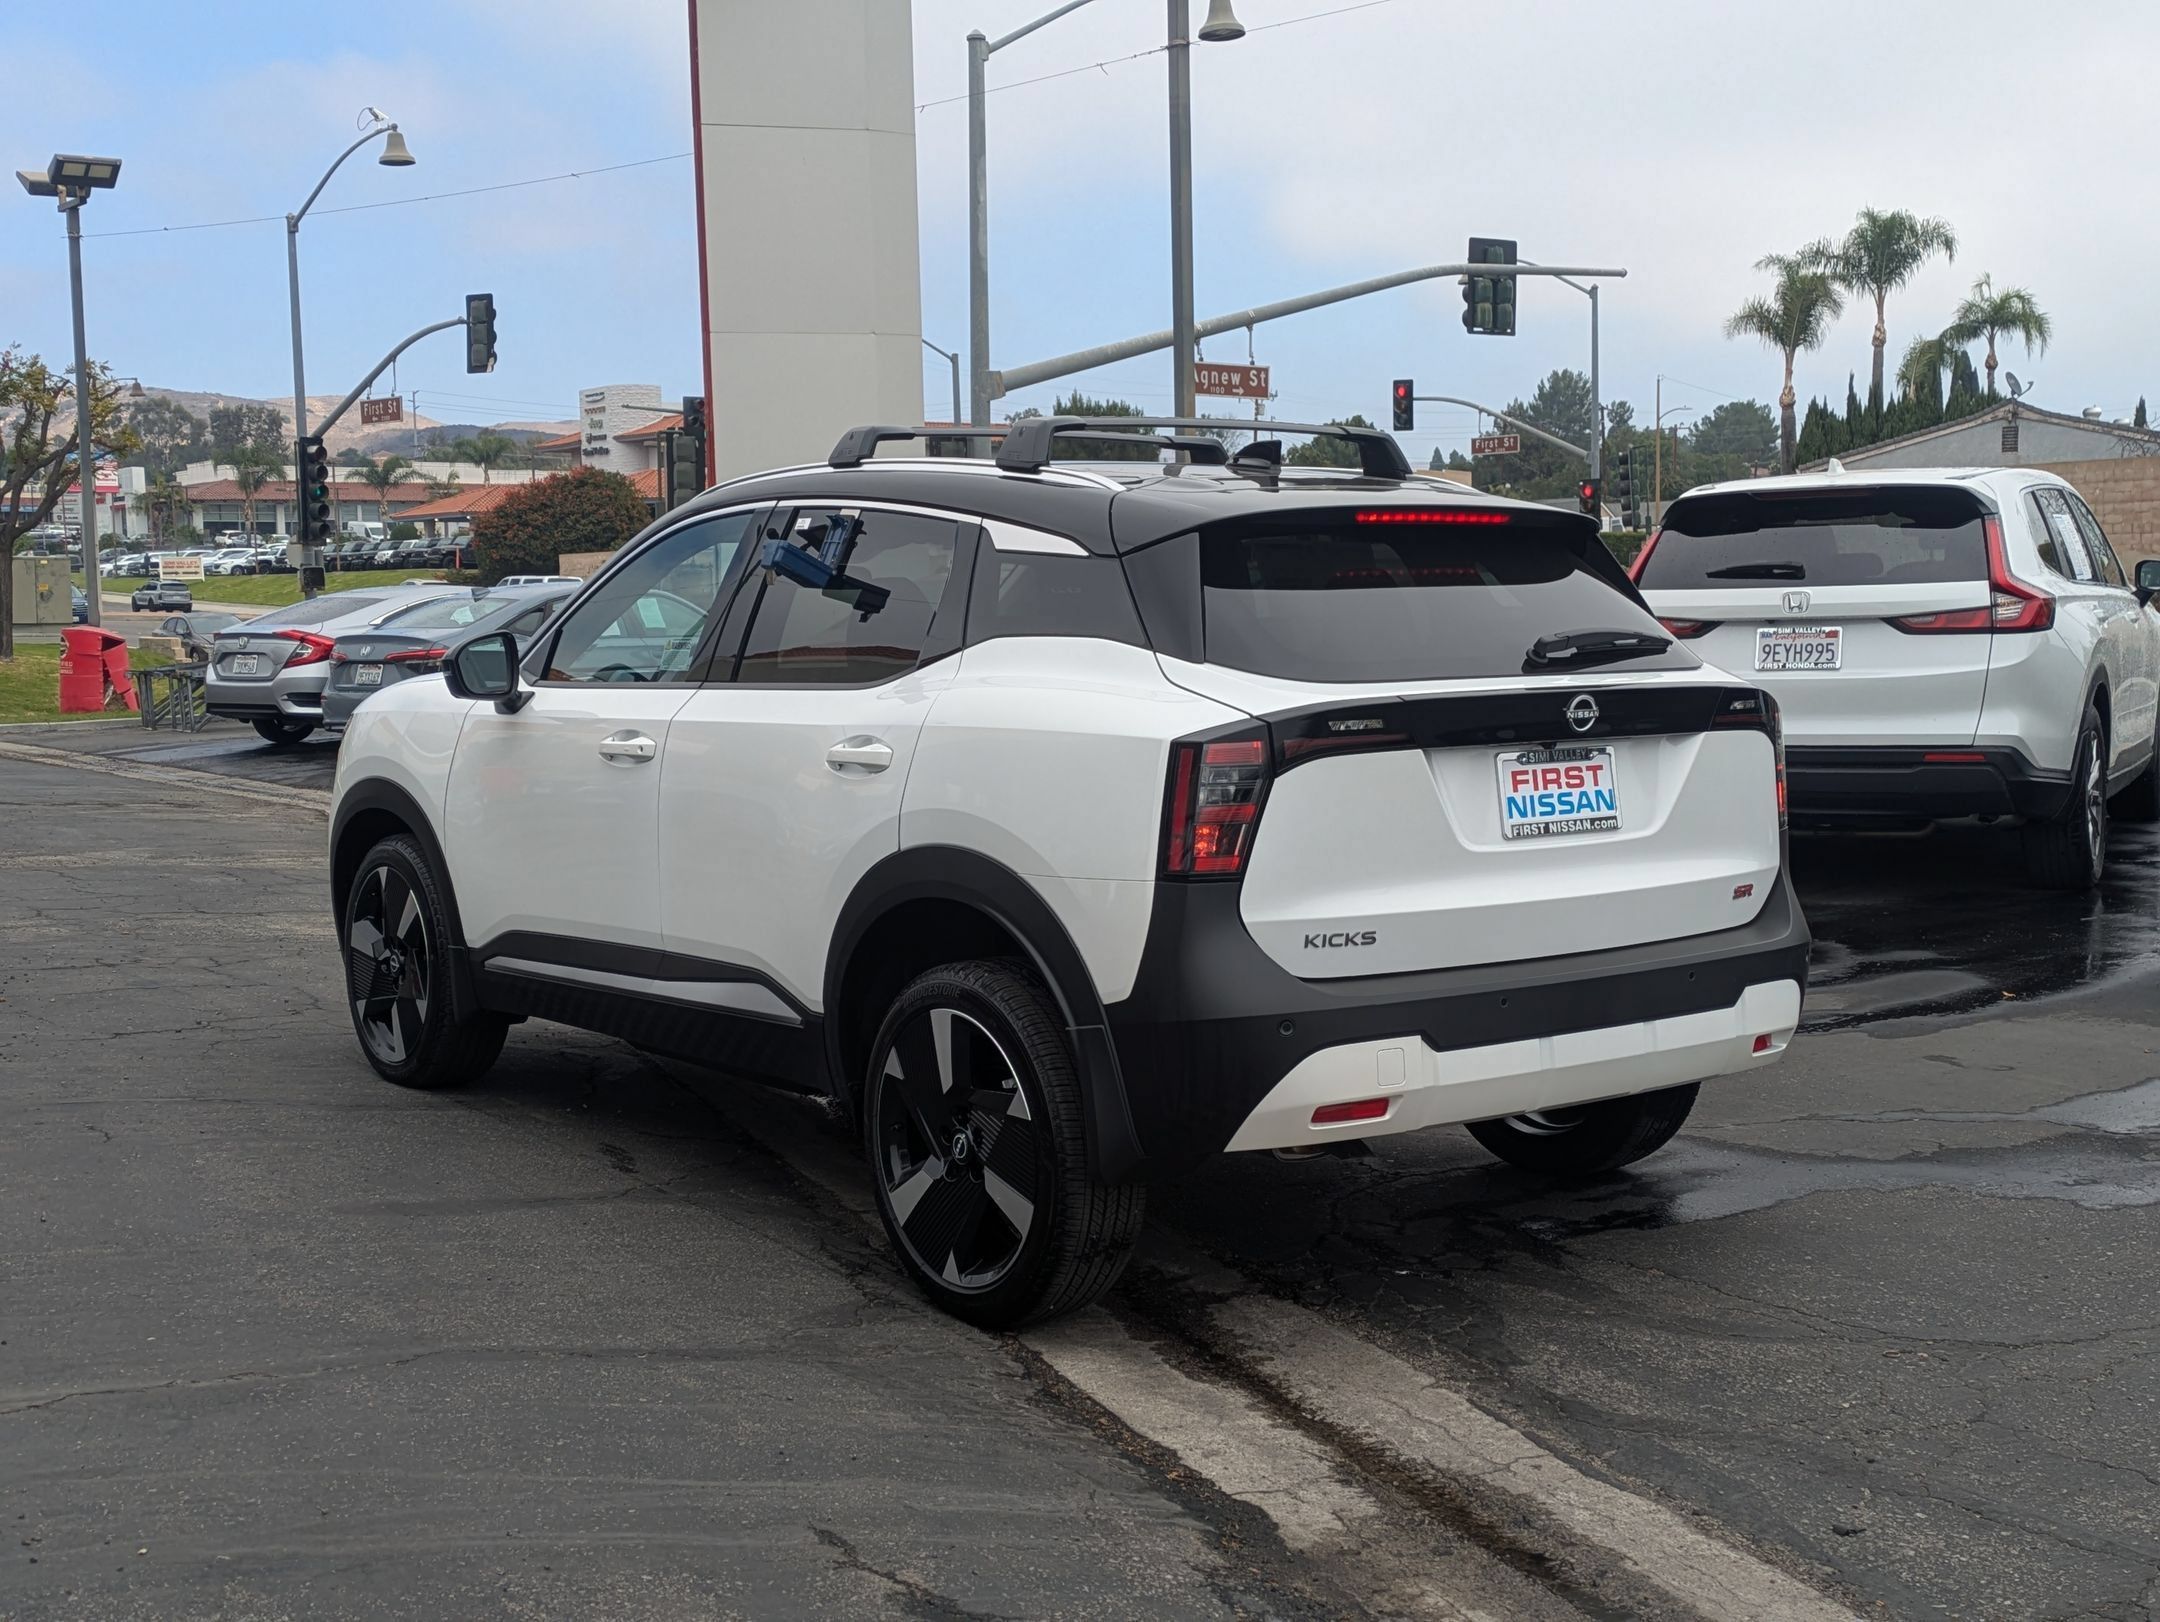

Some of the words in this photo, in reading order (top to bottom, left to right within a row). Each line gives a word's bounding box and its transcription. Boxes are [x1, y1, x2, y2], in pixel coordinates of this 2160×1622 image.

[1249, 369, 1267, 388] St
[363, 401, 384, 417] First
[388, 400, 397, 413] St
[1475, 438, 1498, 449] First
[1503, 437, 1514, 447] St
[1794, 626, 1820, 634] VALLEY
[1761, 642, 1835, 663] 9EYH995
[1567, 711, 1599, 719] NISSAN
[1529, 752, 1549, 763] SIMI
[1553, 748, 1587, 761] VALLEY
[1511, 764, 1603, 793] FIRST
[1507, 788, 1615, 819] NISSAN
[1513, 823, 1545, 836] FIRST
[1549, 818, 1617, 833] NISSAN.com
[1733, 883, 1754, 900] SR
[1304, 930, 1377, 949] KICKS
